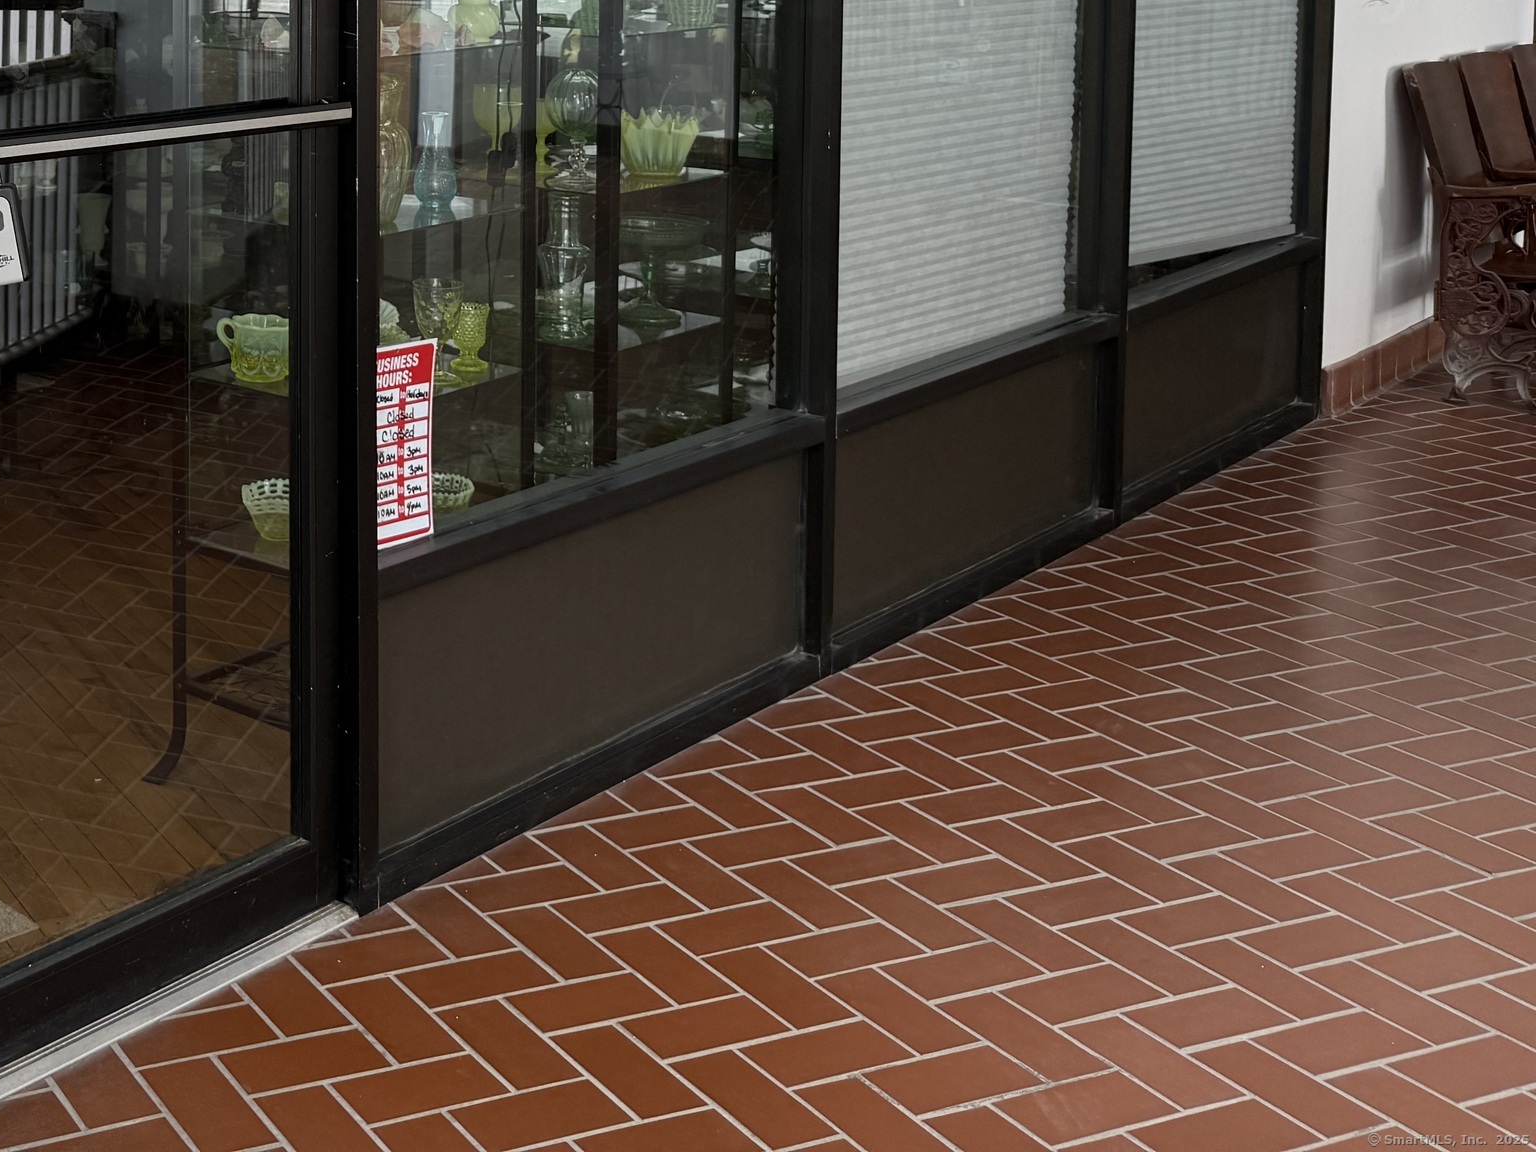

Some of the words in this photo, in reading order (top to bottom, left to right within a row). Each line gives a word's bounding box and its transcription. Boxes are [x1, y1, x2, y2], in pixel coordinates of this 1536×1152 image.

[376, 352, 420, 373] USINESS
[376, 369, 413, 389] HOURS:
[386, 407, 415, 424] Closed
[381, 424, 415, 443] Closed
